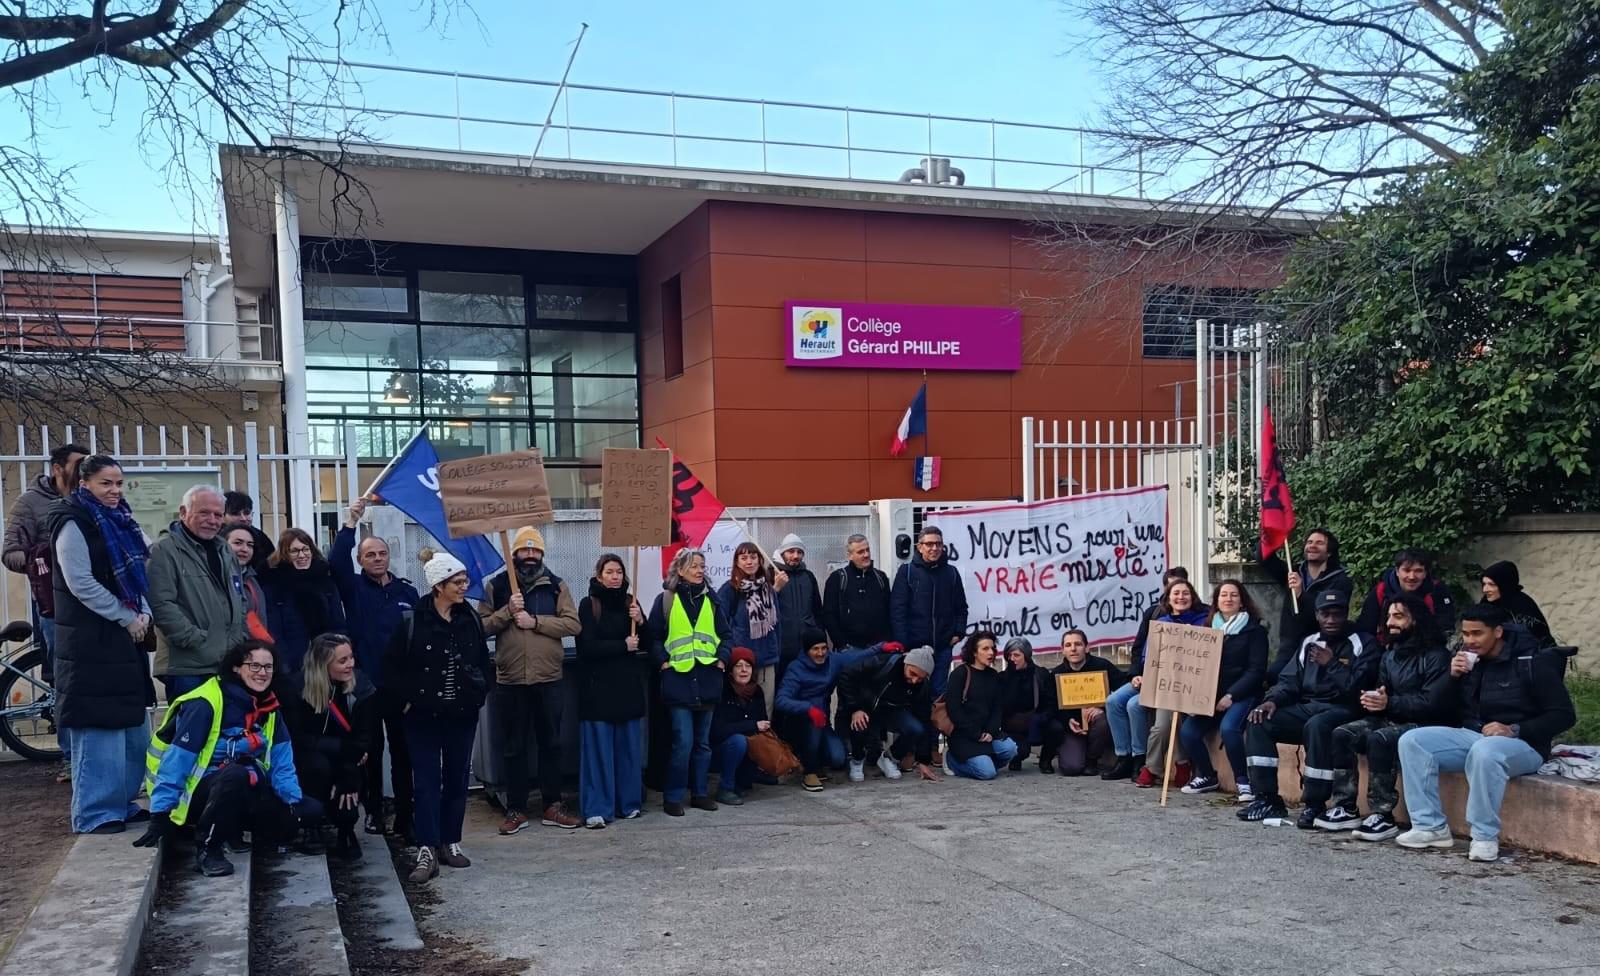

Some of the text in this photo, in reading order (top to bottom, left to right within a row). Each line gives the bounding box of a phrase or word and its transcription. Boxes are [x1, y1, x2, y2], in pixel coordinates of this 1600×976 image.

[847, 317, 901, 337] Collège
[848, 339, 960, 355] Gérard PHILIPE
[943, 522, 1164, 561] es MOYENS pour une
[1061, 545, 1148, 584] mixité
[965, 586, 1160, 637] arents en COLÈRE
[1183, 630, 1218, 643] MOYEN
[1173, 662, 1204, 676] FAIRE
[1158, 678, 1193, 695] BIEN
